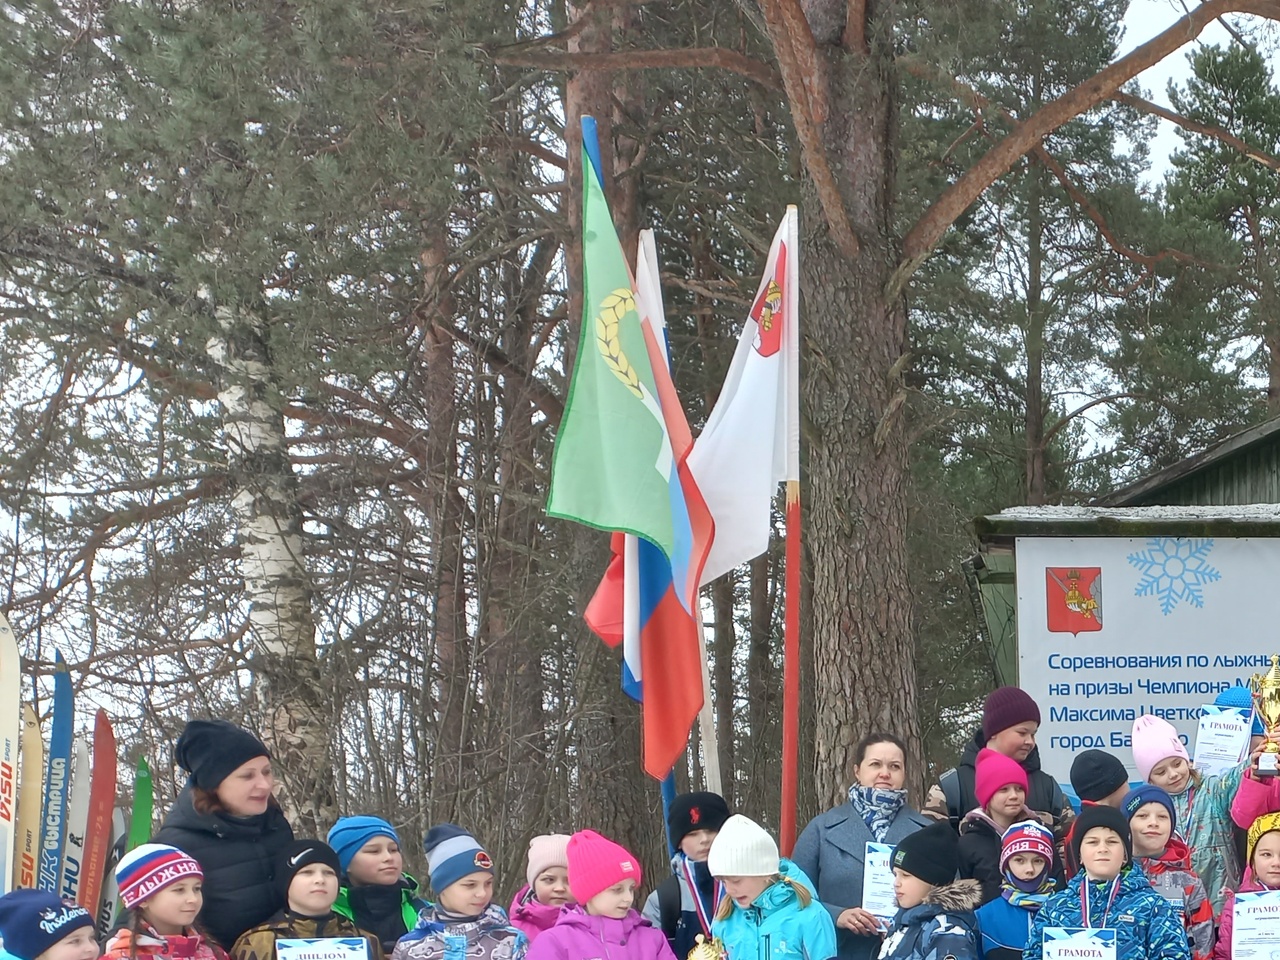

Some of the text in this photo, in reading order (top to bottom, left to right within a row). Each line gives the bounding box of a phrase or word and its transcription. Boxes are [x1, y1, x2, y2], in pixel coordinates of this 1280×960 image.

[1048, 654, 1182, 672] Соревнования
[1186, 656, 1209, 667] по
[1048, 683, 1070, 696] на
[1075, 682, 1132, 699] призы
[1137, 679, 1230, 695] Чемпиона
[1050, 706, 1136, 722] Максима
[1209, 721, 1243, 732] ГРАМОТА
[1051, 735, 1106, 751] город
[137, 861, 199, 898] ЛЫЖНЯ
[294, 952, 346, 960] ДИПЛОМ
[1058, 948, 1103, 958] ГРАМОТА
